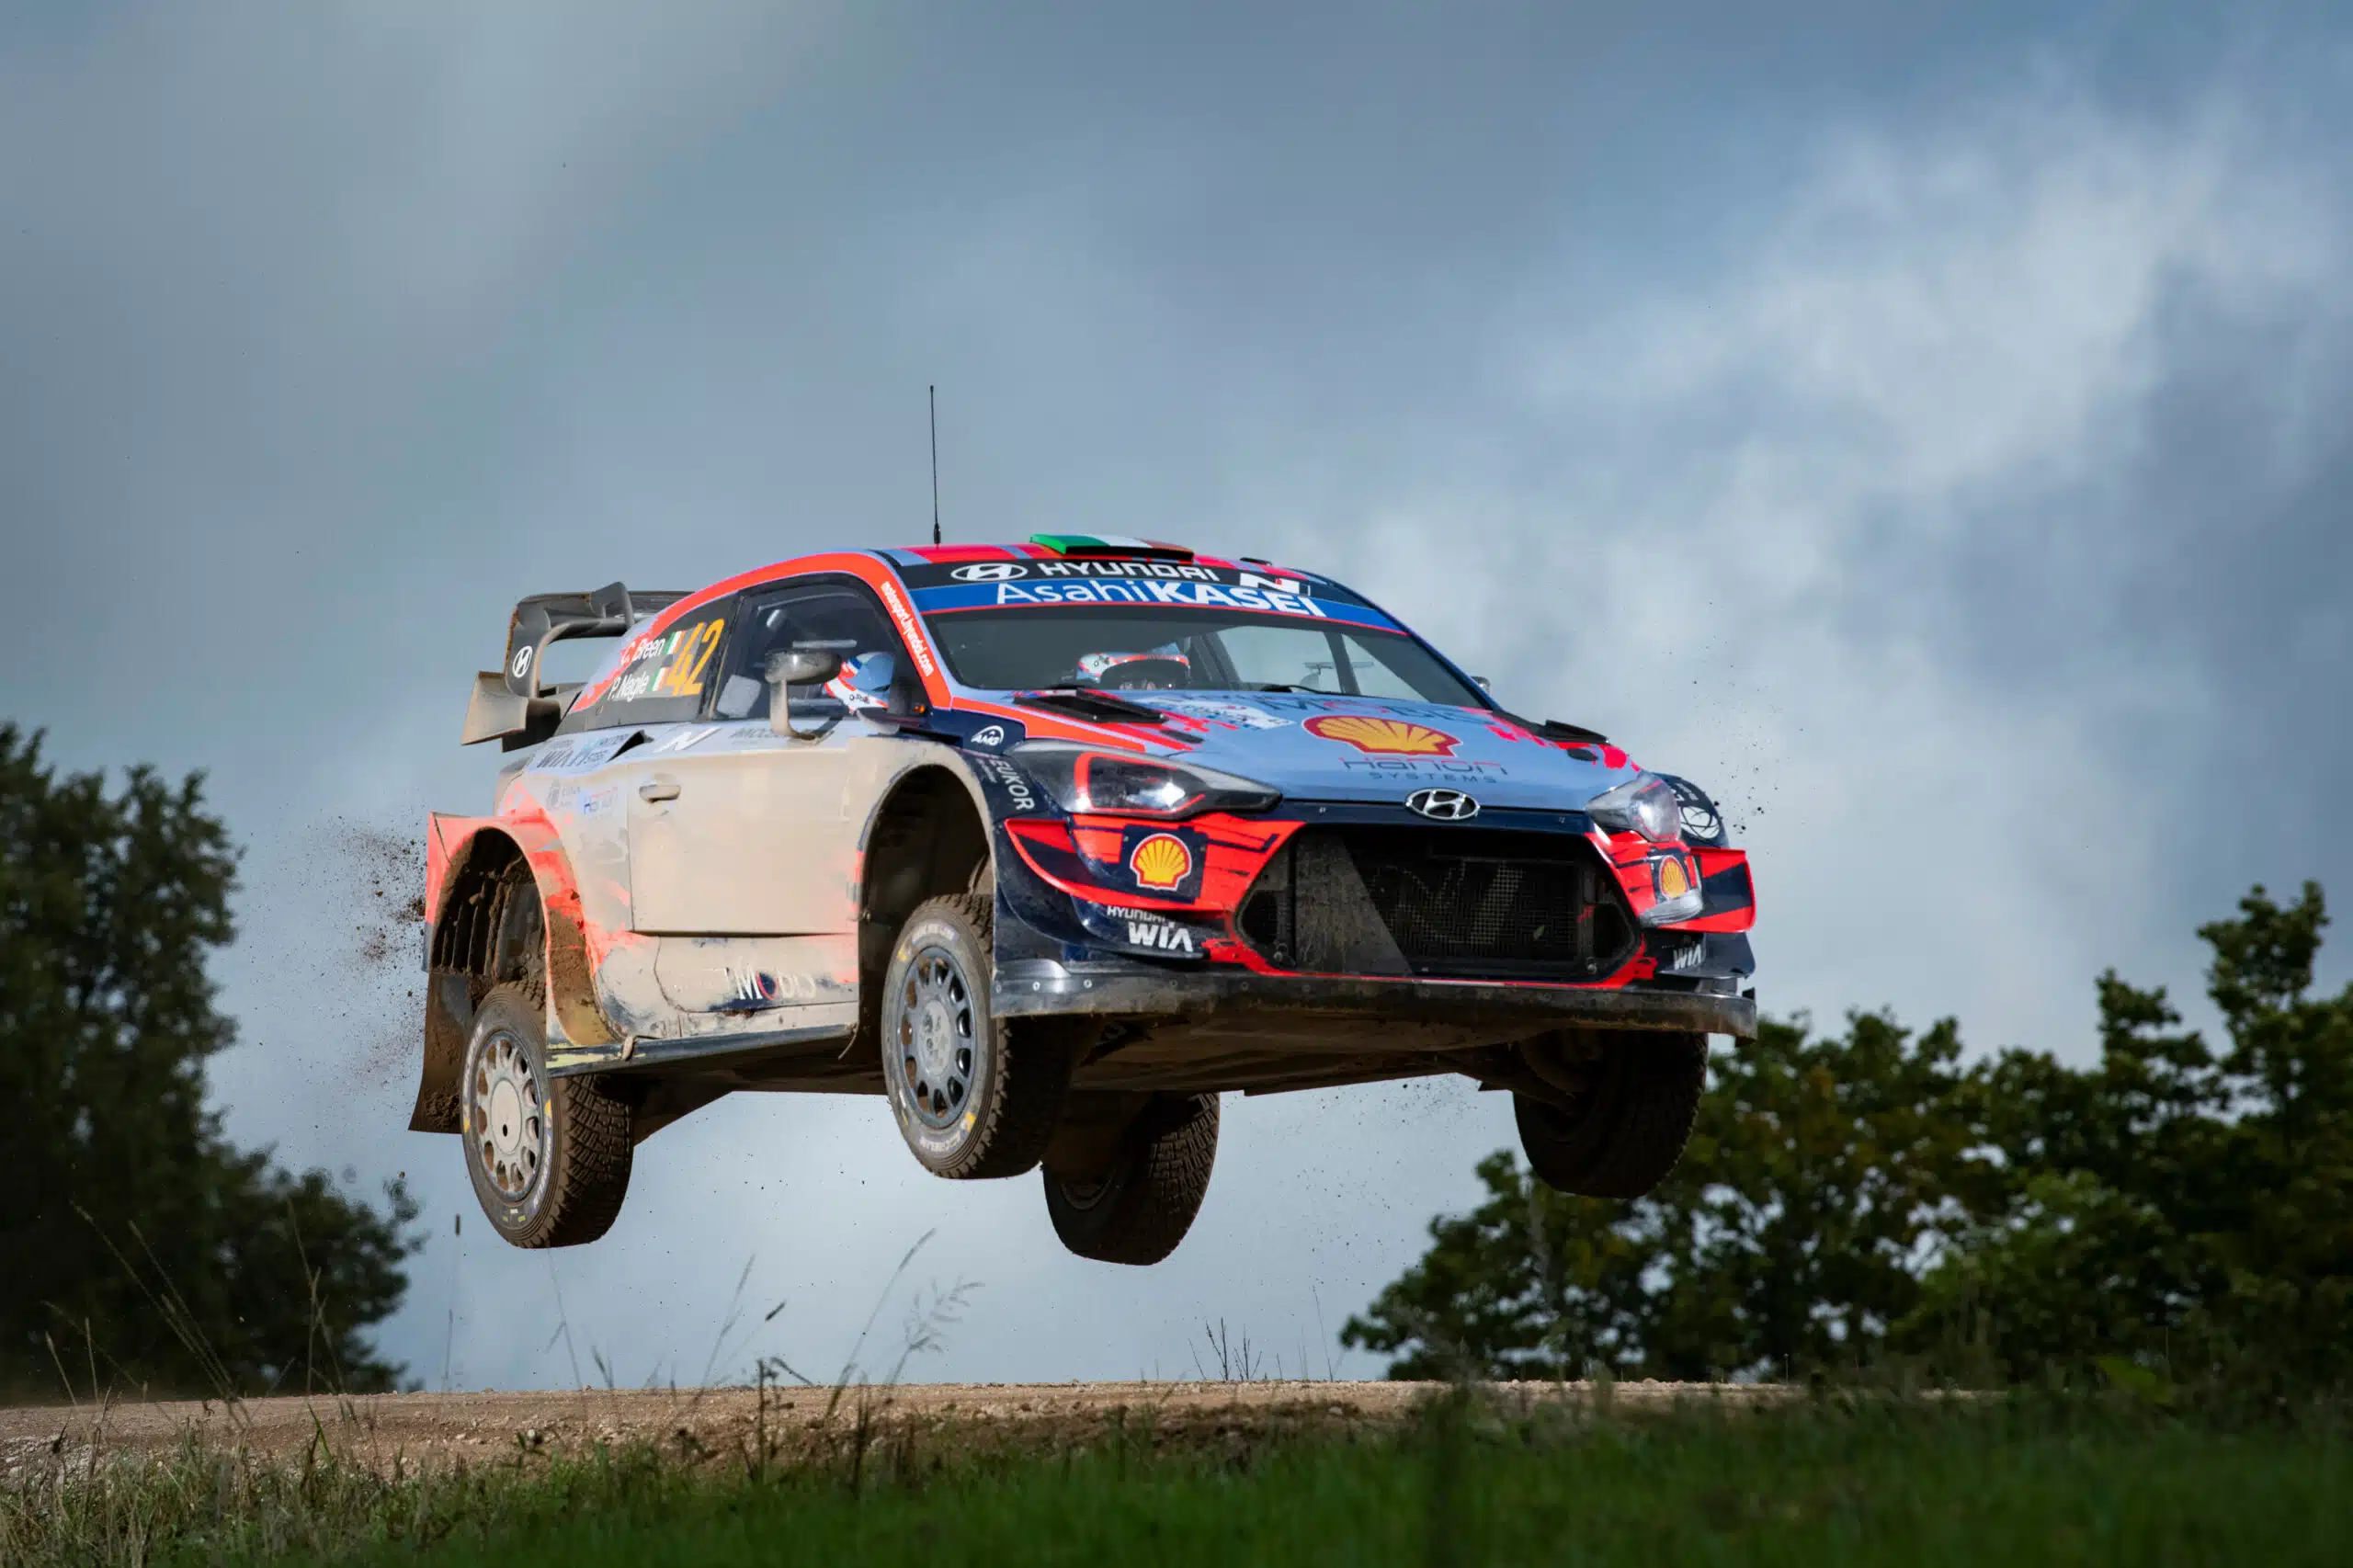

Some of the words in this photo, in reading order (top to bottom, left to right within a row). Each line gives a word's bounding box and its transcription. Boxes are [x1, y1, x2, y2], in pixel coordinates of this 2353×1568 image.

[1036, 562, 1221, 582] HYUNDAI
[631, 637, 666, 662] Breen
[666, 618, 725, 697] 42
[615, 671, 650, 702] Nagle
[988, 758, 1036, 810] EUKOR
[1368, 771, 1497, 783] SYSTEMS
[1128, 921, 1194, 953] WIA
